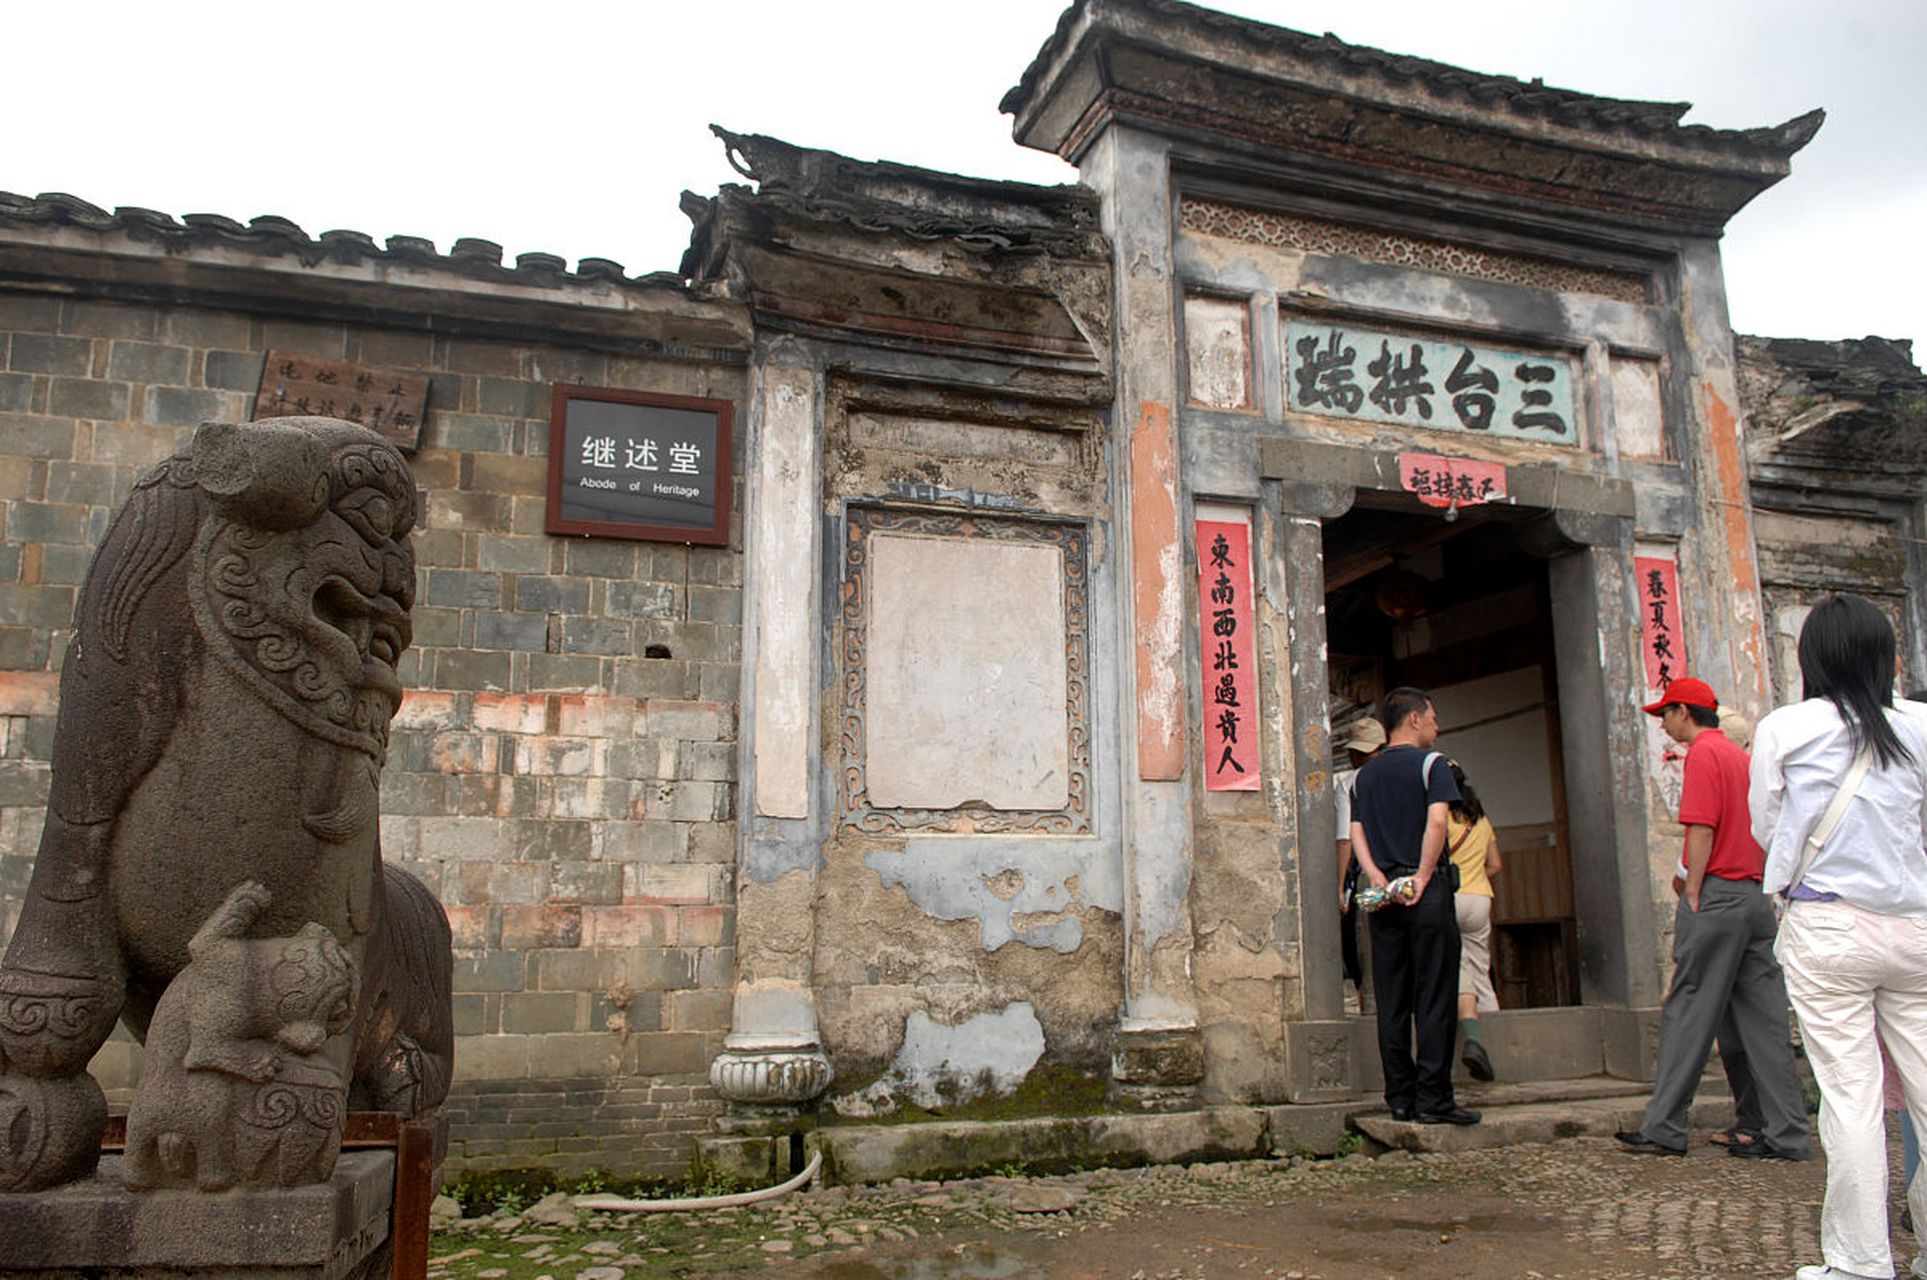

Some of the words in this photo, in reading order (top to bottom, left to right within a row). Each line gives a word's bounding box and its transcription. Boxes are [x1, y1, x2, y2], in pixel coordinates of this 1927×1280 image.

[581, 436, 701, 475] 继述堂
[580, 477, 616, 490] Abode
[629, 482, 640, 491] of
[653, 483, 700, 497] Heritage
